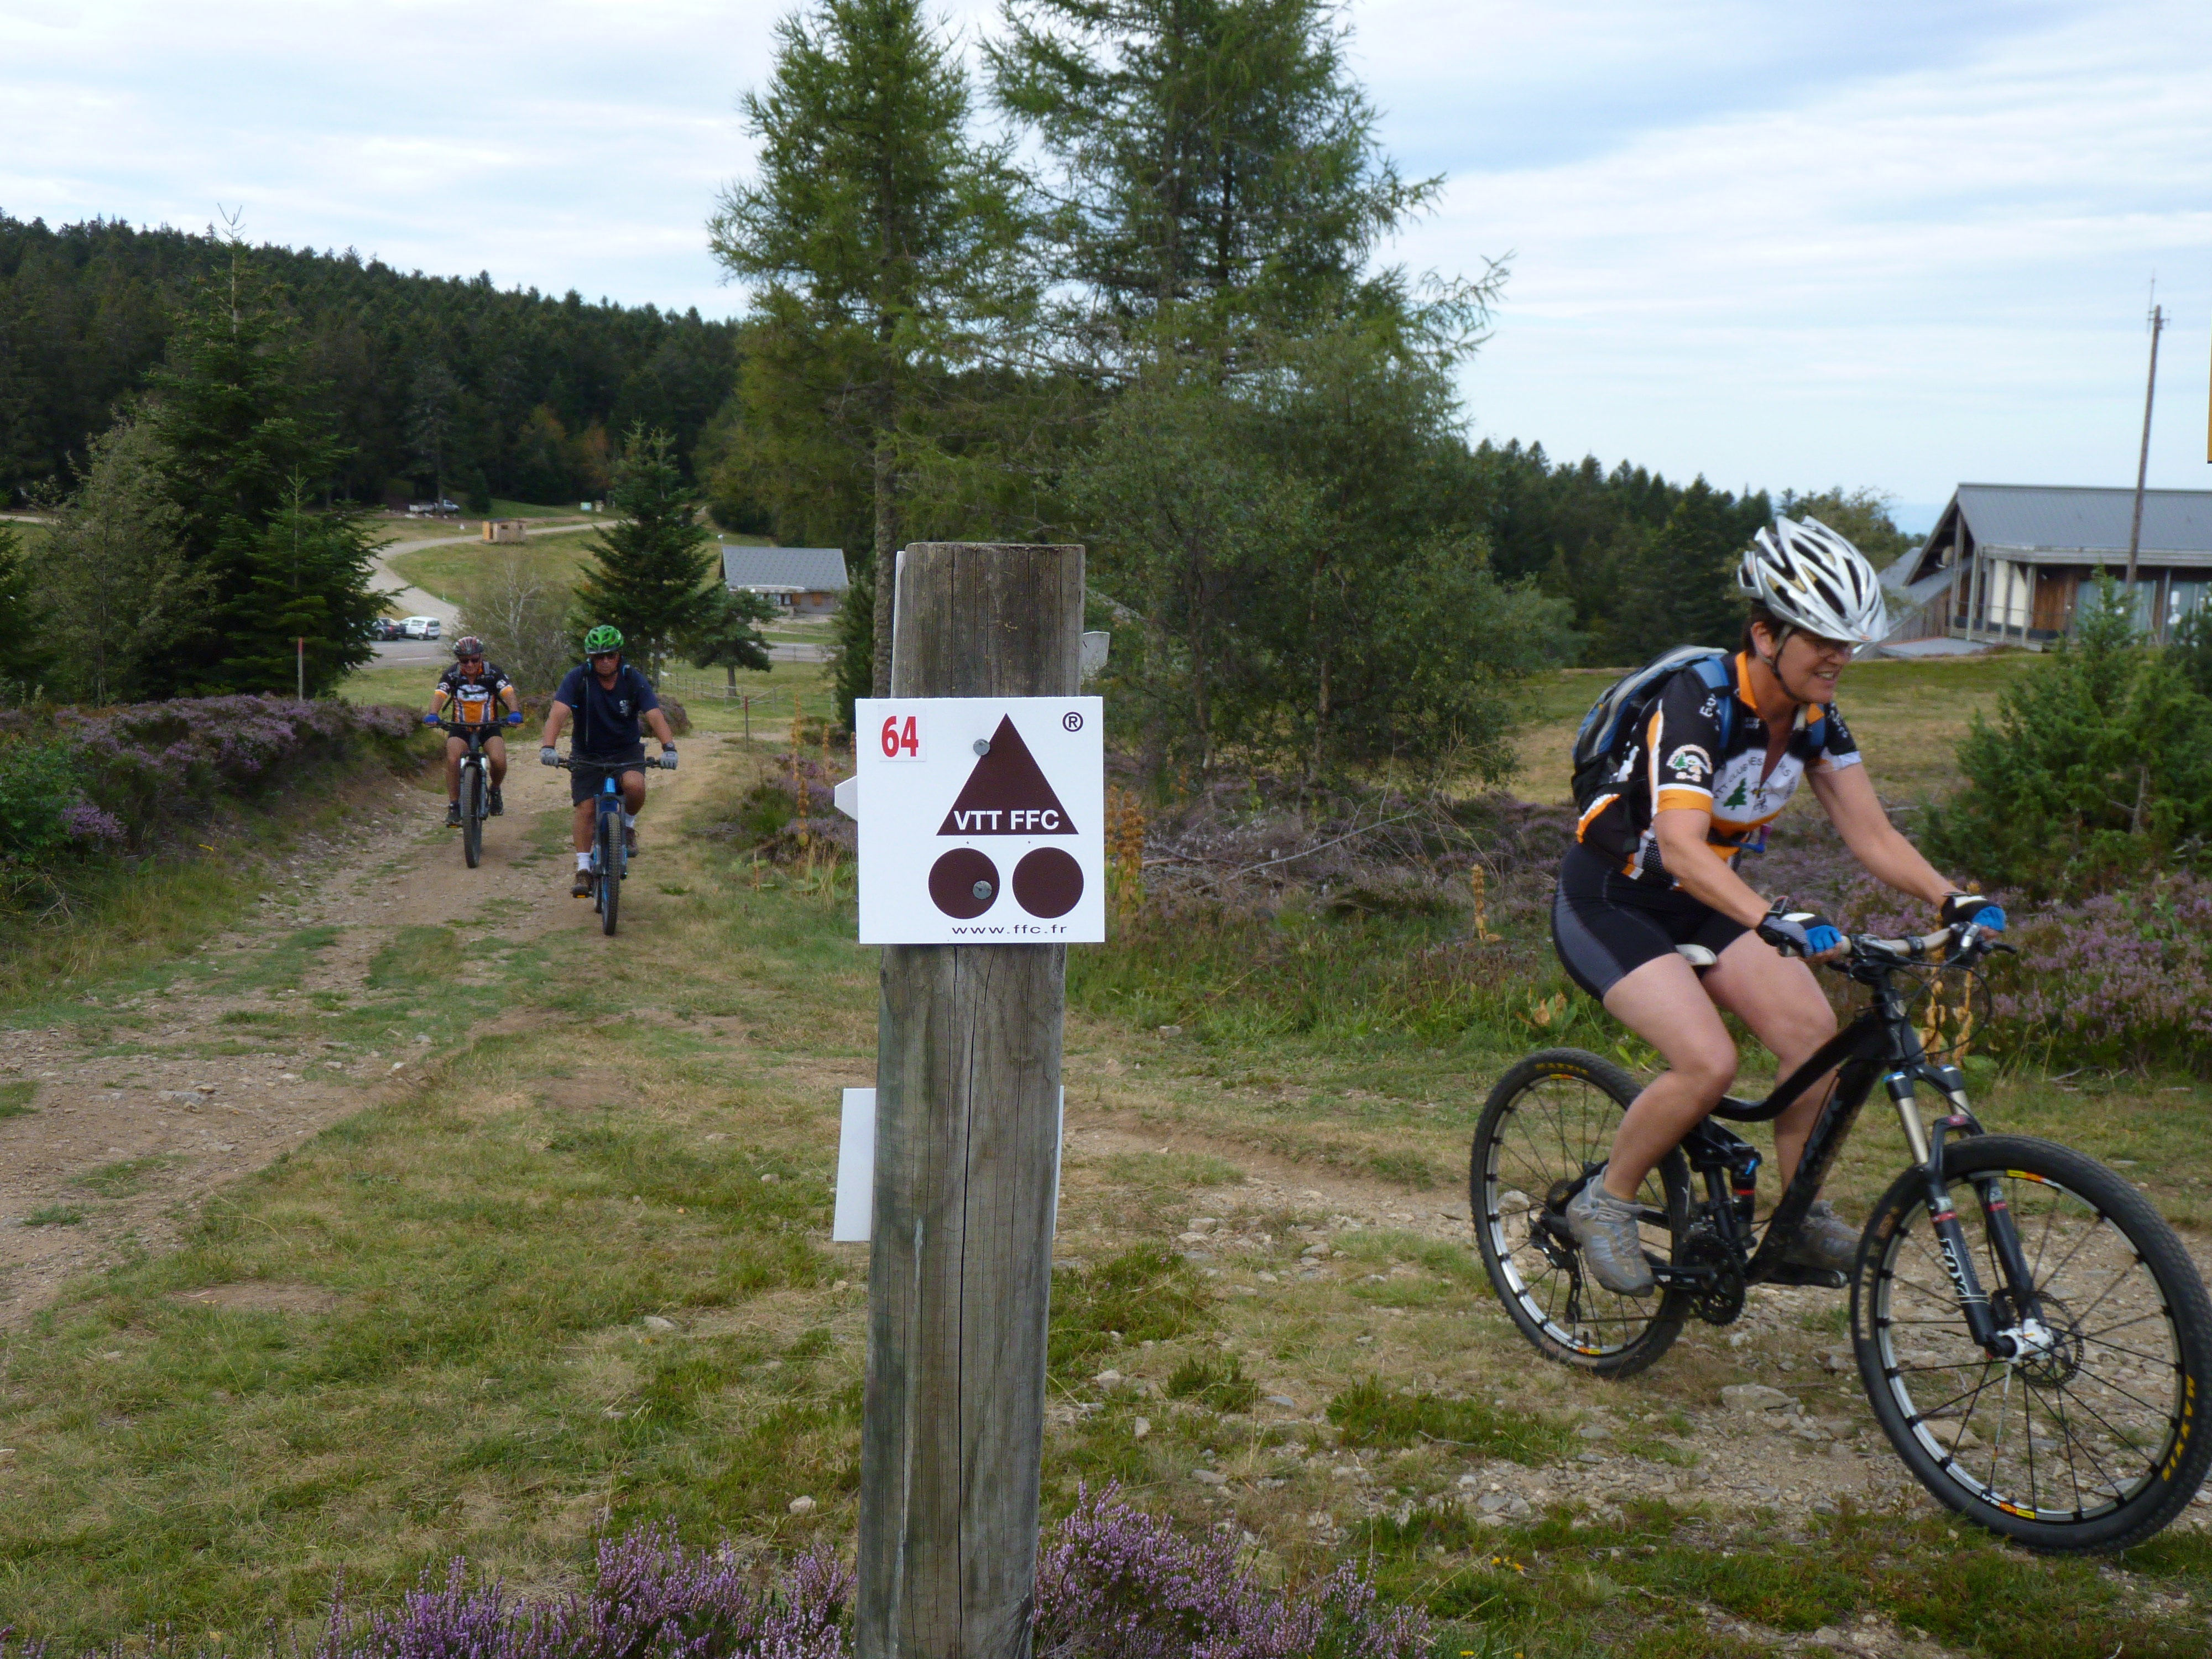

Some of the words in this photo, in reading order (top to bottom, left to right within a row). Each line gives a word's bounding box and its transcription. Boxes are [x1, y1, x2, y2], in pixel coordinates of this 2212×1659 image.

[881, 715, 919, 758] 64
[953, 810, 1002, 831] VTT
[1010, 809, 1060, 830] FFC
[951, 924, 1068, 935] www.ffc.fr
[2162, 1374, 2196, 1483] MAXXIS
